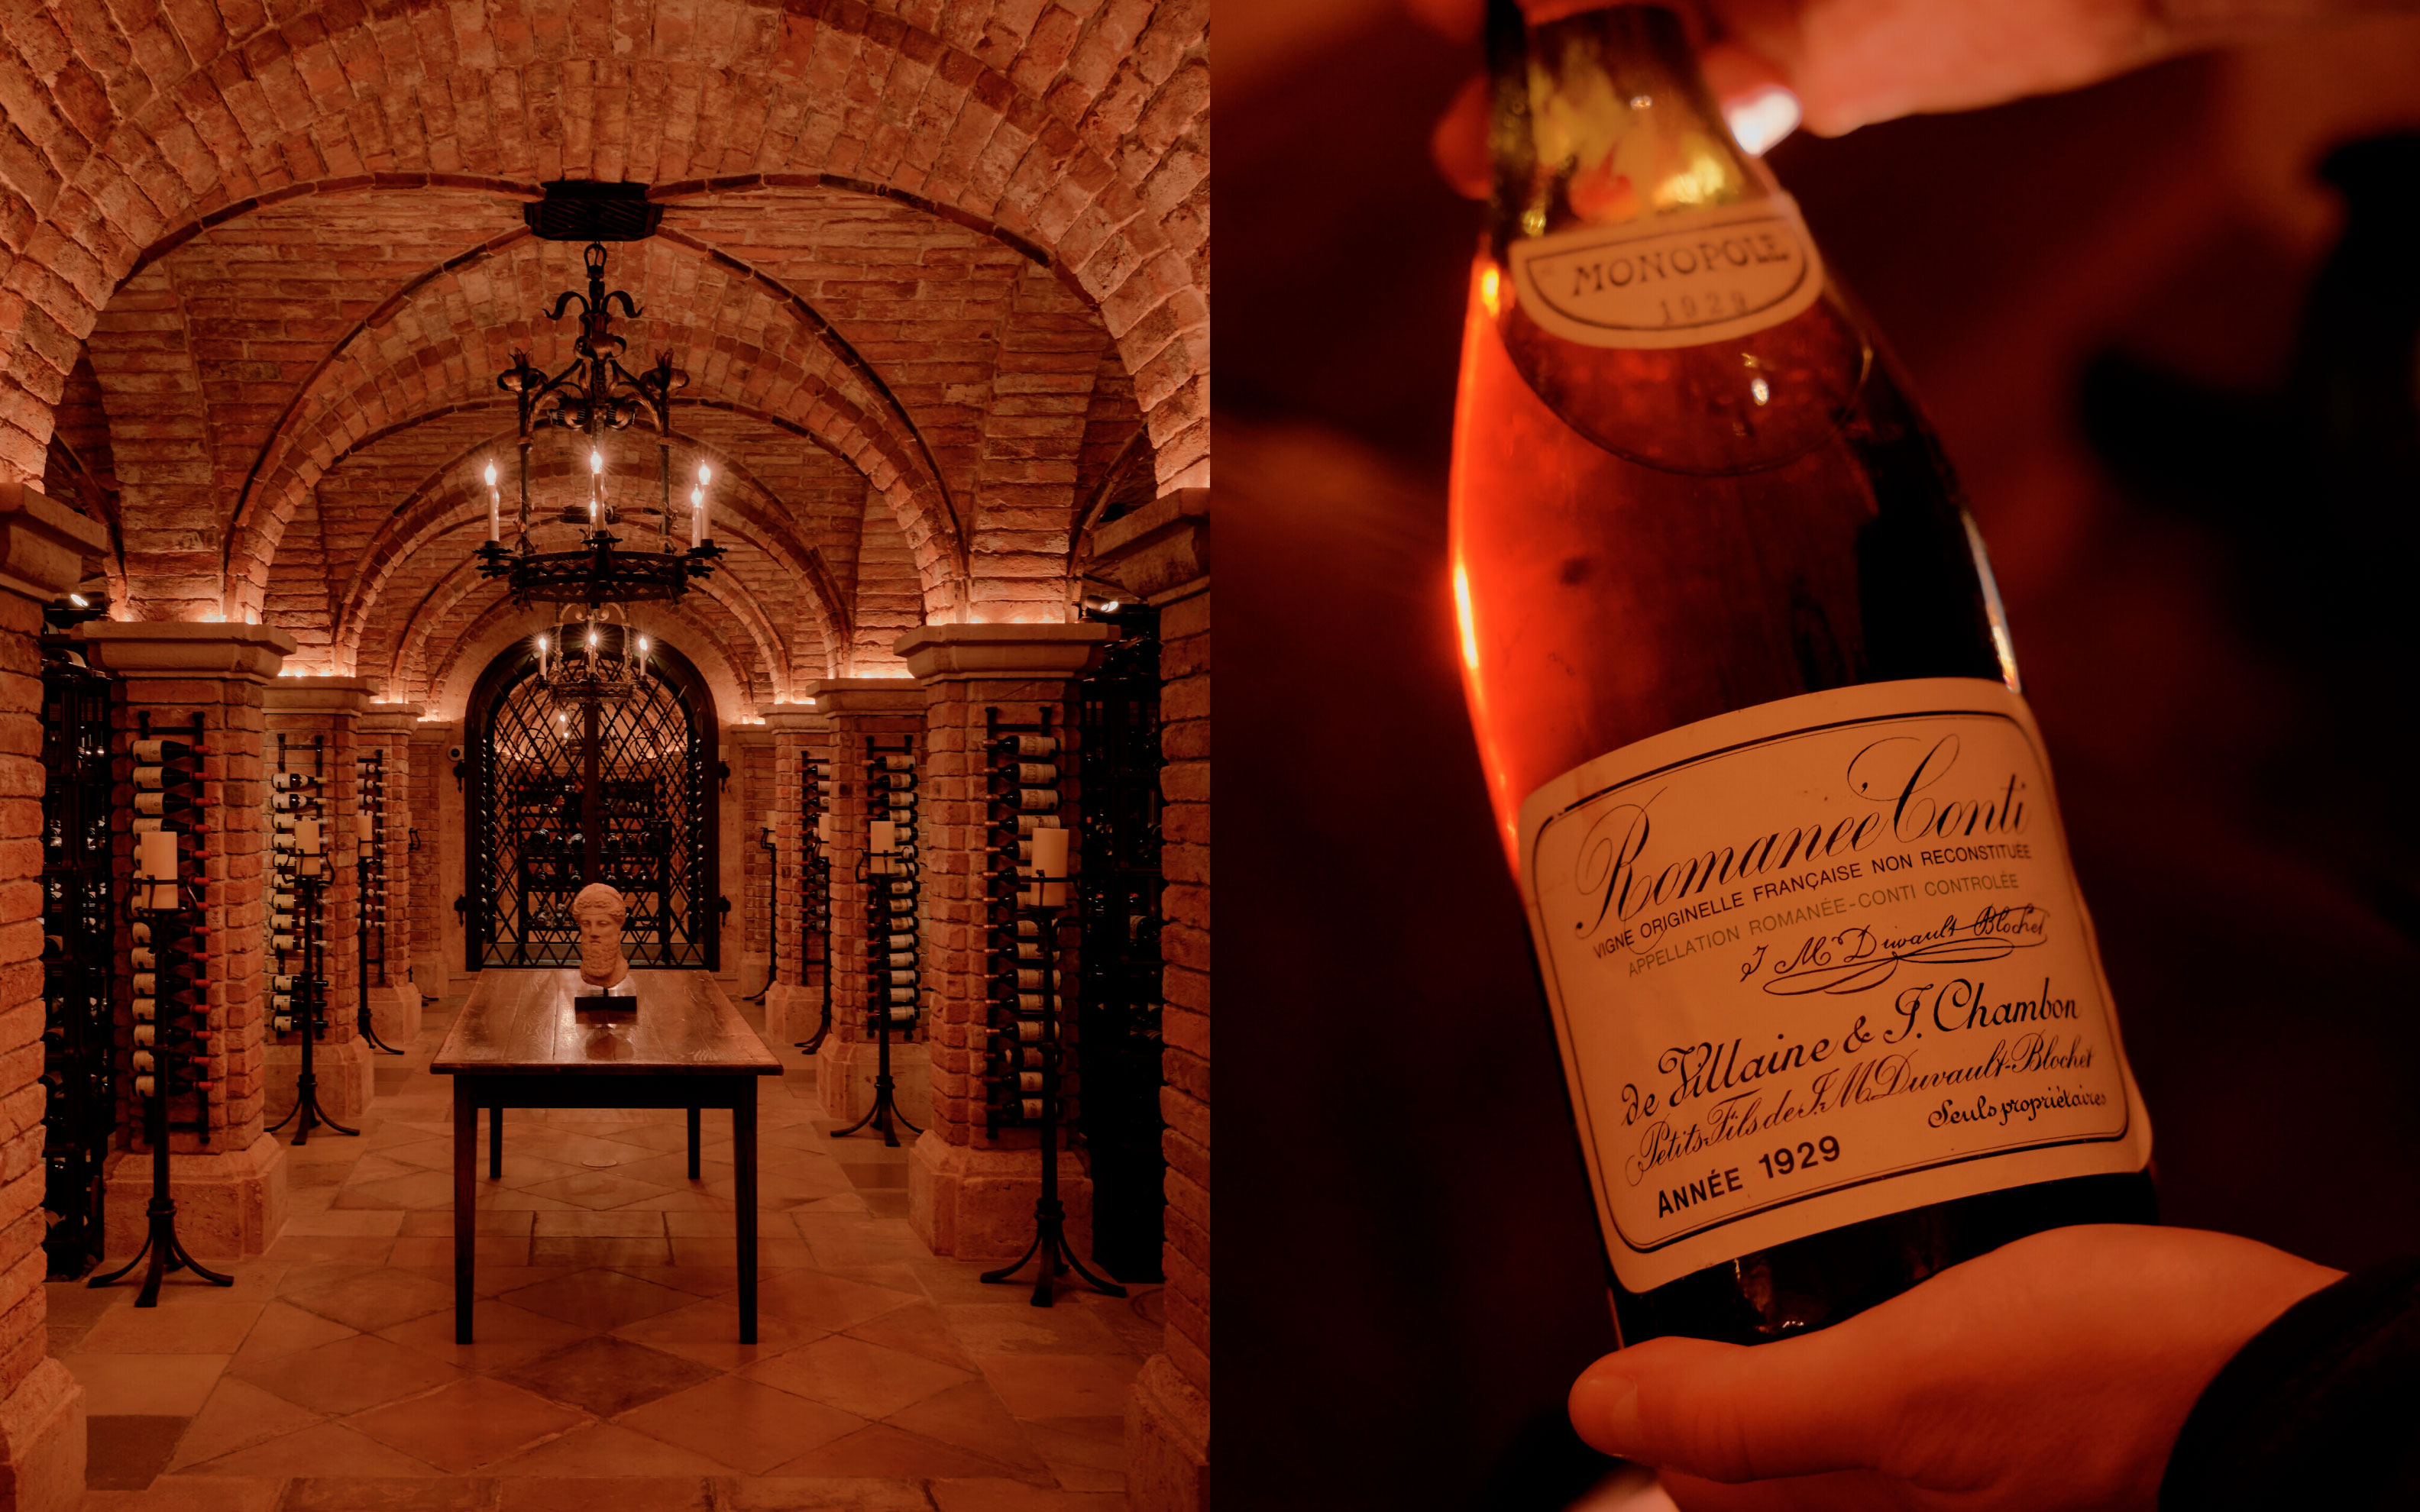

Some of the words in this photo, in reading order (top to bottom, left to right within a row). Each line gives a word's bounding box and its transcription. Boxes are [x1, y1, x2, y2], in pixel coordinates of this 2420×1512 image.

[1572, 234, 1789, 296] MONOPOLE
[1660, 290, 1747, 325] 1929
[1847, 734, 2027, 842] Conti
[1593, 929, 1634, 959] VIGNE
[1640, 892, 1745, 939] ORIGINELLE
[1752, 863, 1863, 902] FRANÇAISE
[1872, 854, 1913, 874] NON
[1921, 843, 2032, 867] RECONSTITUÉE
[1629, 926, 1740, 977] APPELLATION
[1749, 884, 1916, 935] ROMANÉE-CONTI
[1621, 1084, 1660, 1126] de
[1658, 1034, 1839, 1107] Villaine
[1843, 1016, 1875, 1053] &
[1933, 977, 2079, 1032] Chambon
[1928, 1095, 1998, 1128] Seuls
[1658, 1168, 1743, 1219] ANNÉE
[1758, 1136, 1840, 1178] 1929
